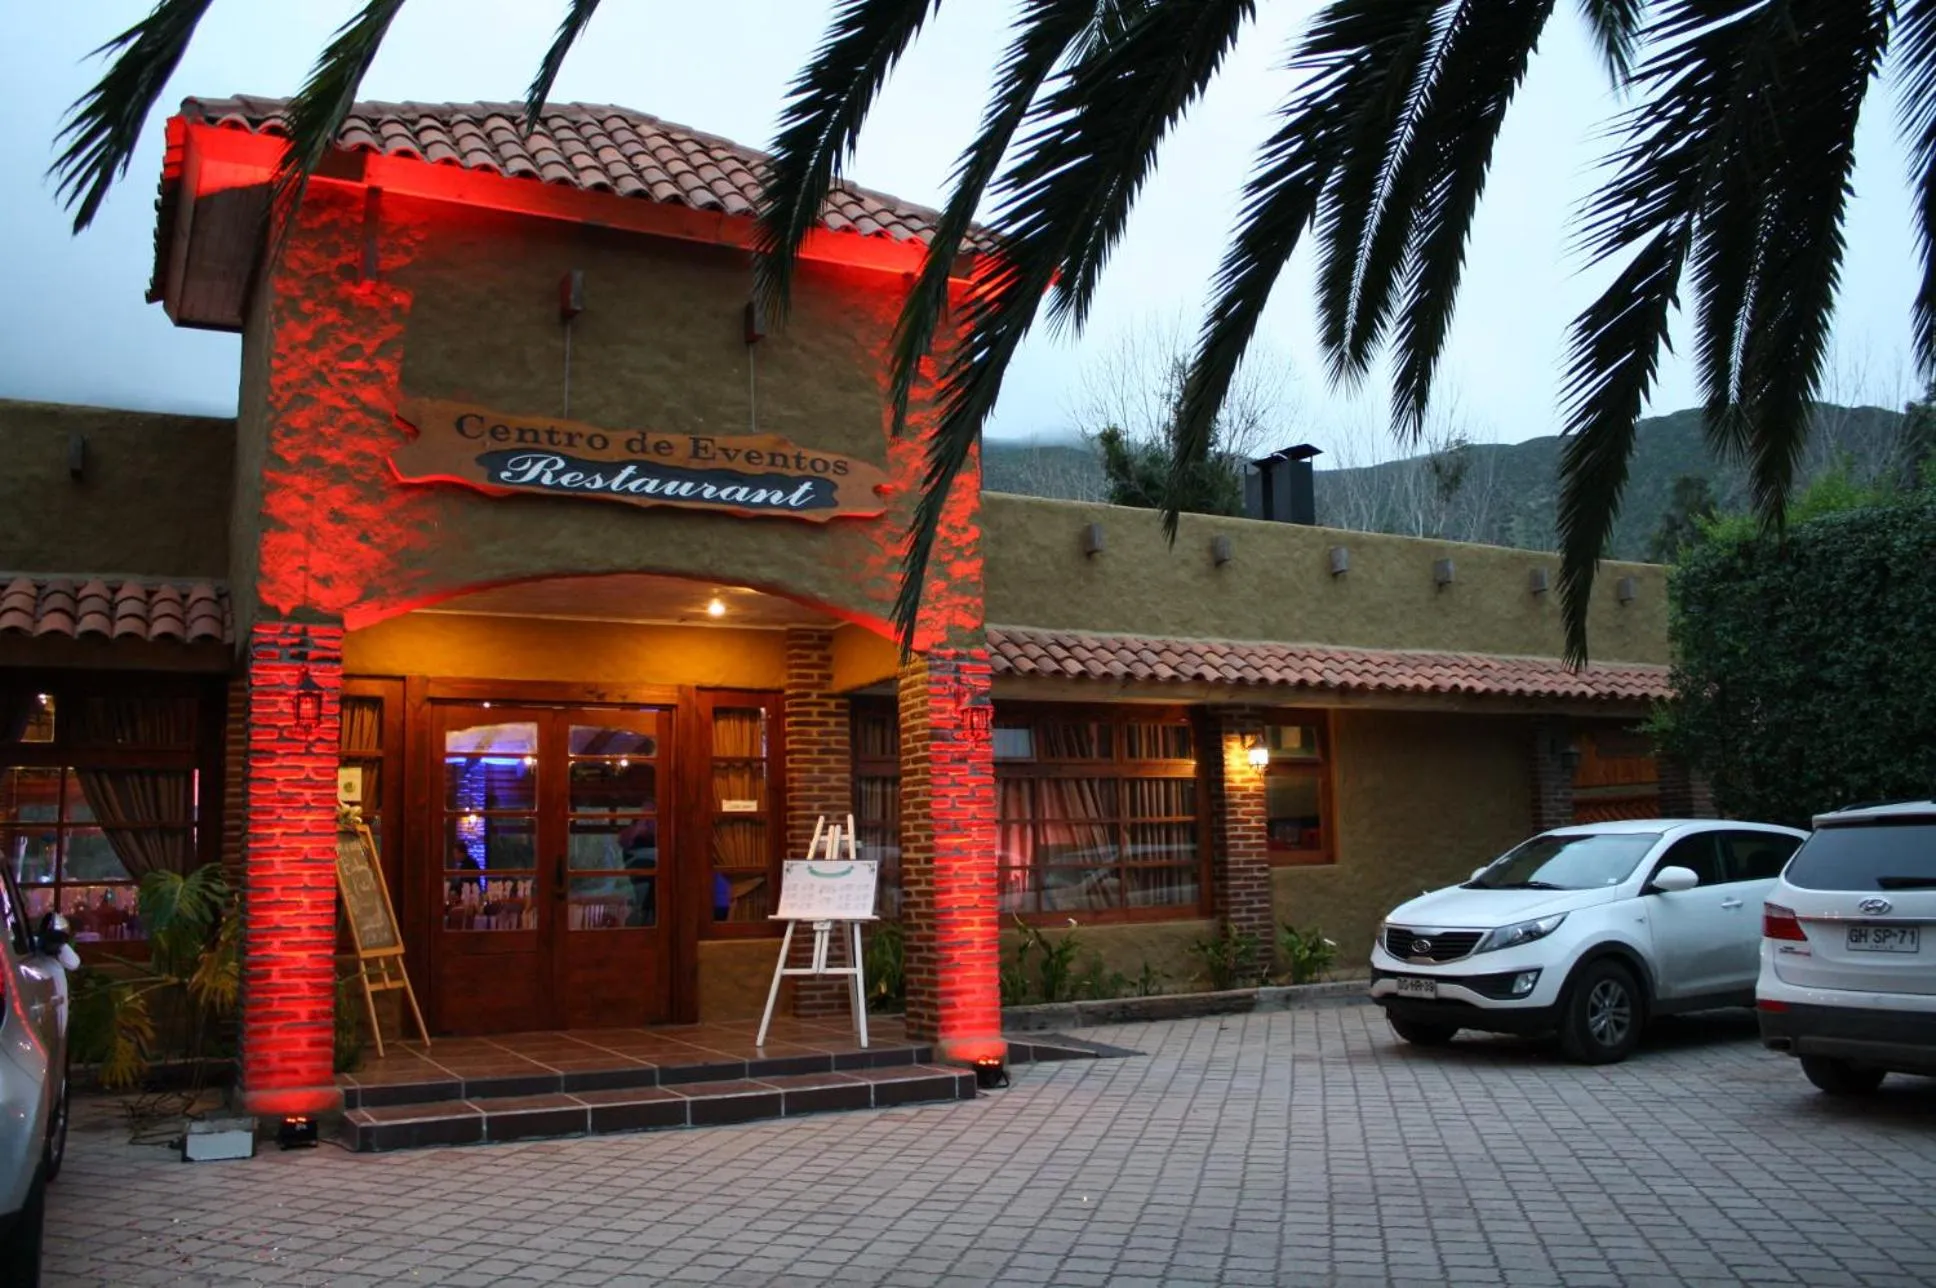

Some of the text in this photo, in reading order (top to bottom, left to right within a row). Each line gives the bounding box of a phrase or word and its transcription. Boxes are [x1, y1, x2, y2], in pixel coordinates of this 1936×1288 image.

[455, 413, 849, 476] Centro de Eventos
[500, 453, 817, 507] Restaurant
